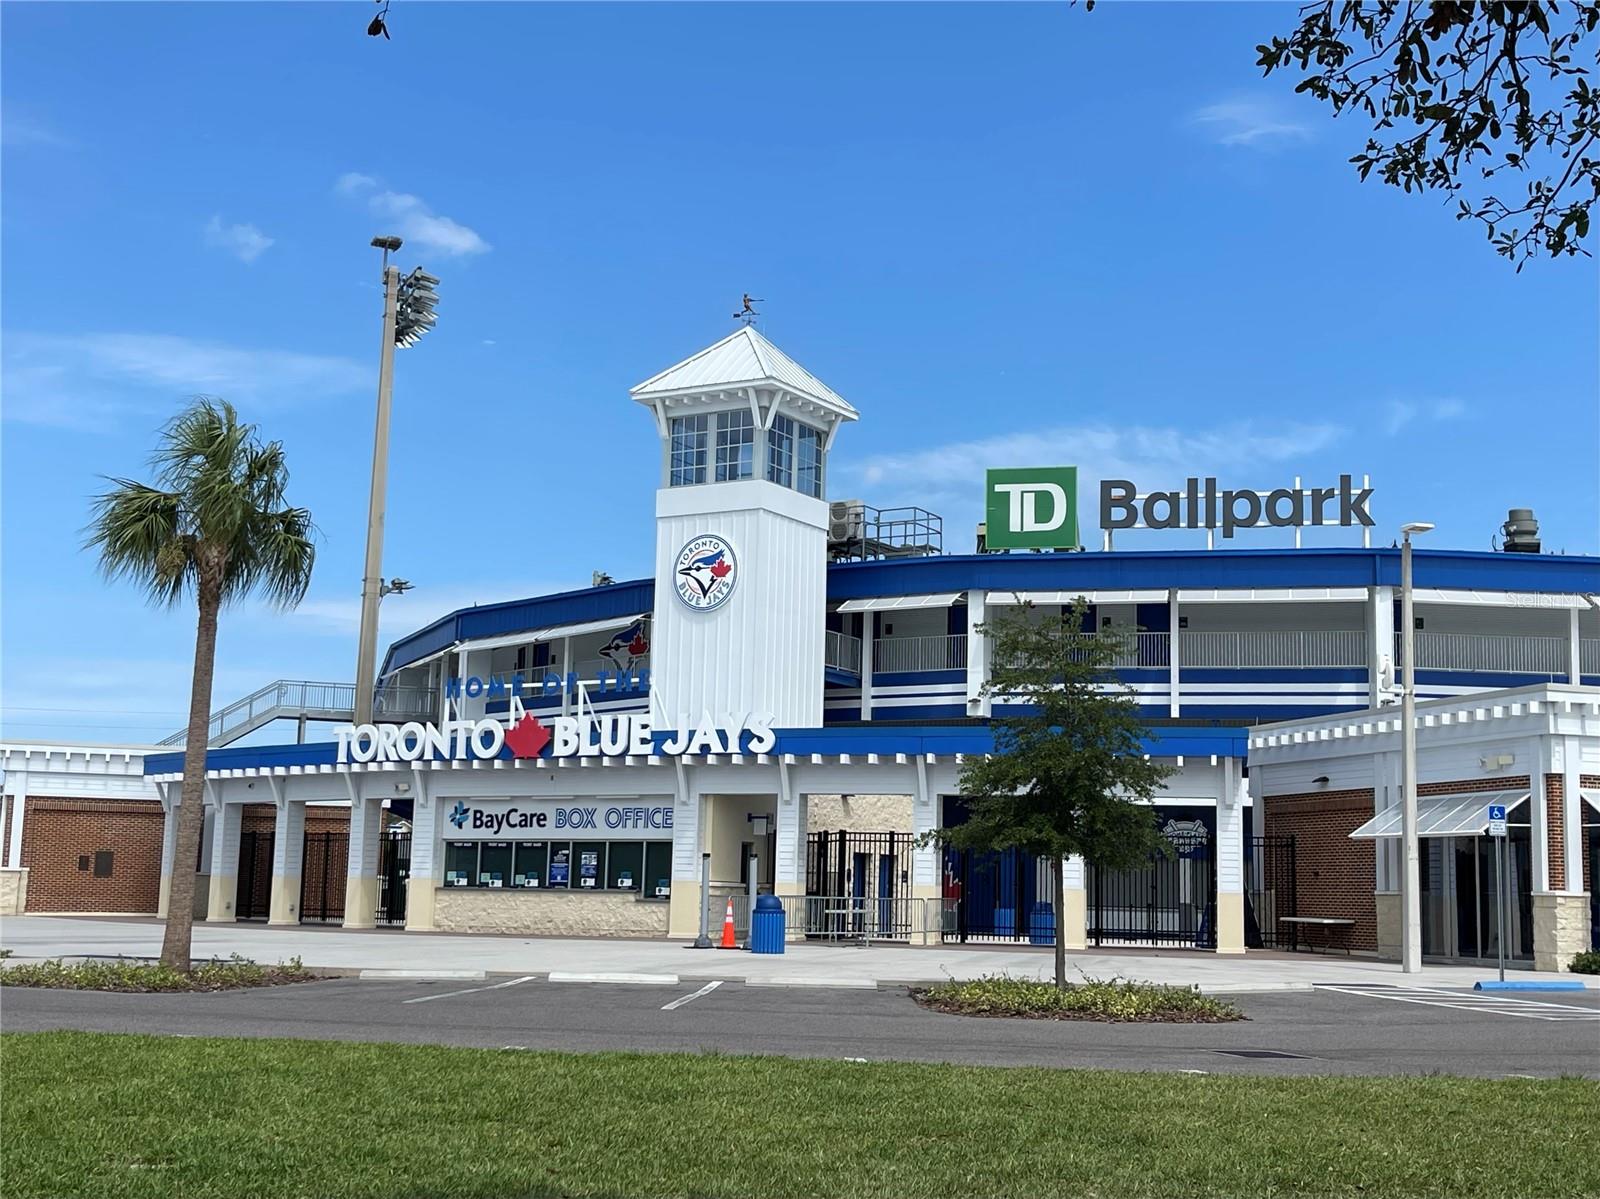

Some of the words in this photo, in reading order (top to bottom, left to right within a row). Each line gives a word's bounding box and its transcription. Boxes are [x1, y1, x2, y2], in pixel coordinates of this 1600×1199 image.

[994, 483, 1067, 532] TD
[1100, 474, 1376, 539] Ballpark
[680, 540, 720, 566] TORONTO
[679, 581, 702, 606] BLUE
[706, 580, 730, 606] JAYS
[446, 671, 525, 699] HOME
[543, 671, 580, 695] OF
[597, 668, 652, 693] THE
[333, 718, 505, 763] TORONTO
[552, 714, 655, 757] BLUE
[662, 710, 776, 755] JAYS
[472, 808, 547, 835] BayCare
[555, 807, 597, 829] BOX
[604, 807, 673, 829] OFFICE
